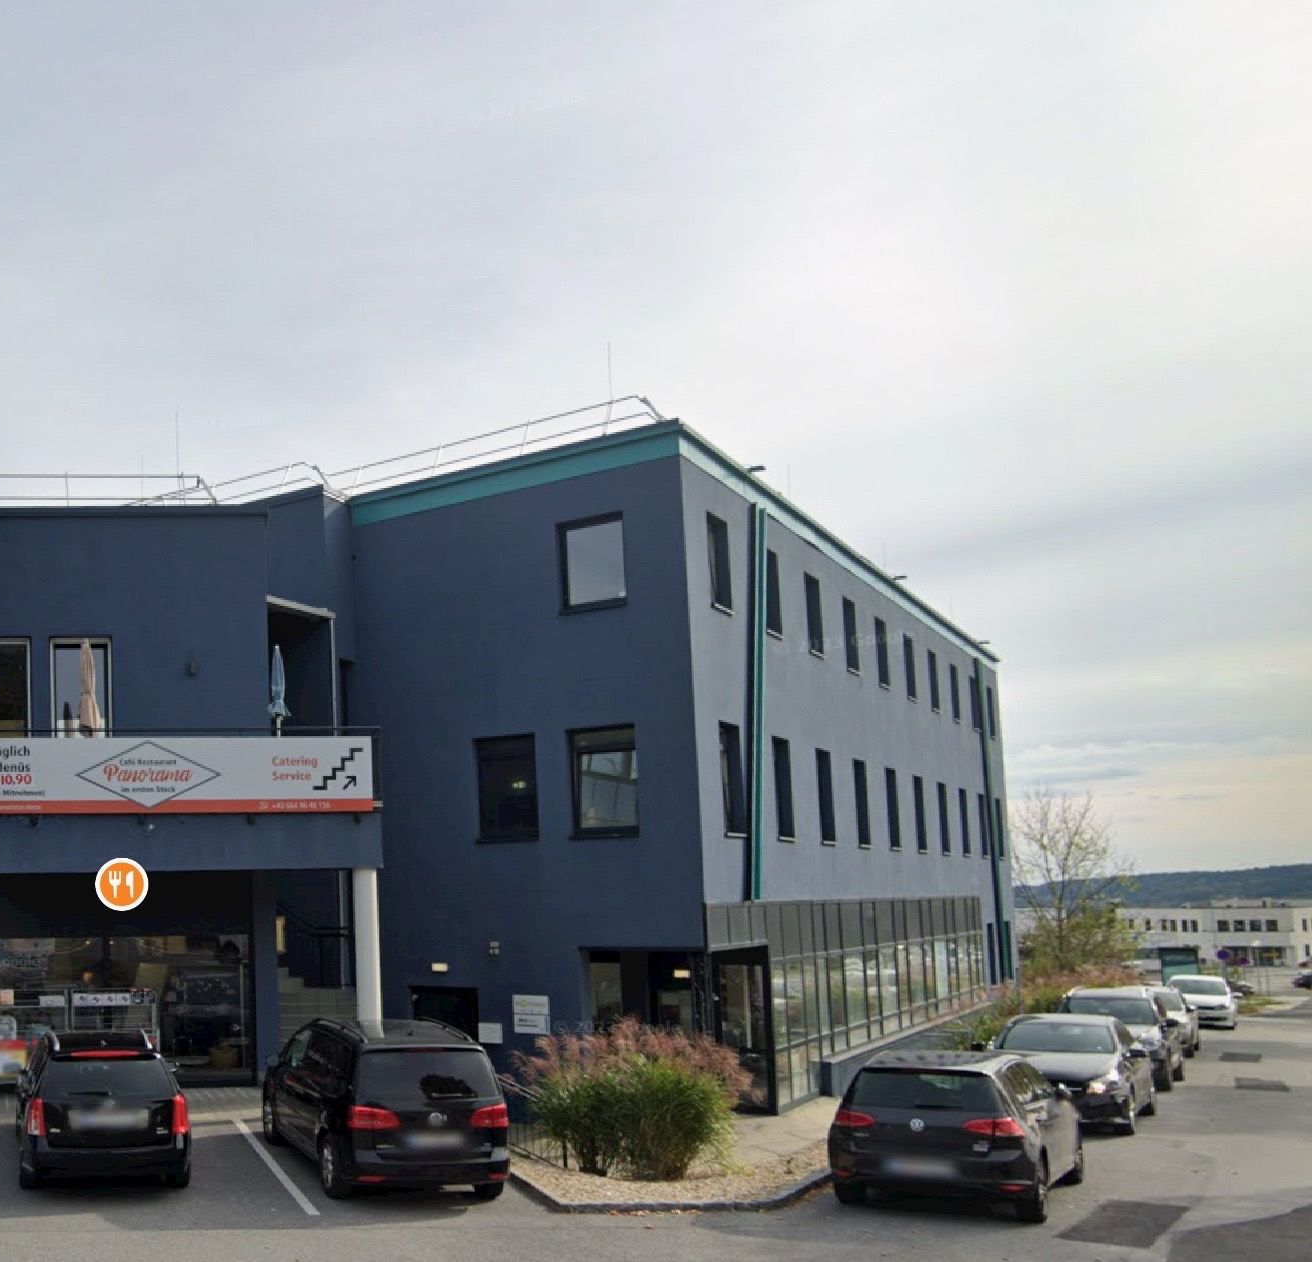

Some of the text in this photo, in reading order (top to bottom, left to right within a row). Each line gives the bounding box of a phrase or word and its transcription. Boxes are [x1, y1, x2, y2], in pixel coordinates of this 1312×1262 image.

[272, 756, 319, 769] Catering
[103, 763, 193, 783] Panorama
[272, 770, 312, 781] Service
[156, 785, 176, 793] Stock
